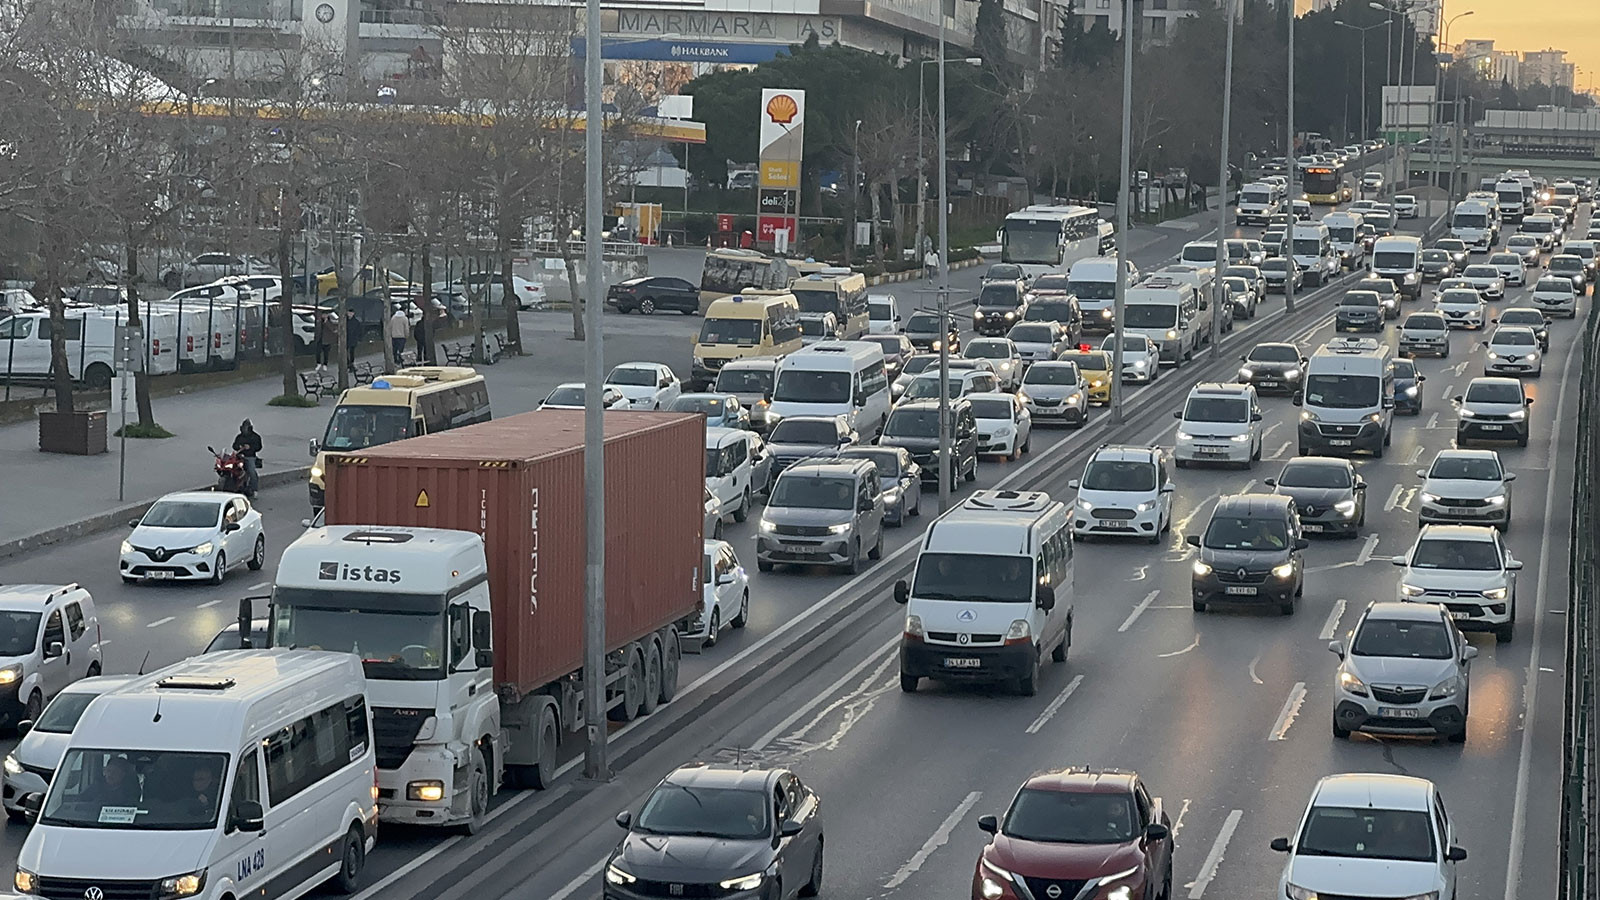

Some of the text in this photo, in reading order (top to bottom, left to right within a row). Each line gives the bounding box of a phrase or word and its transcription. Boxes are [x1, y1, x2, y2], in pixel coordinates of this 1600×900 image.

[621, 13, 772, 36] MARMARA
[682, 46, 729, 57] HALKBANK
[341, 563, 402, 585] istaş
[237, 847, 265, 882] LNA 428
[669, 883, 685, 896] FIAT
